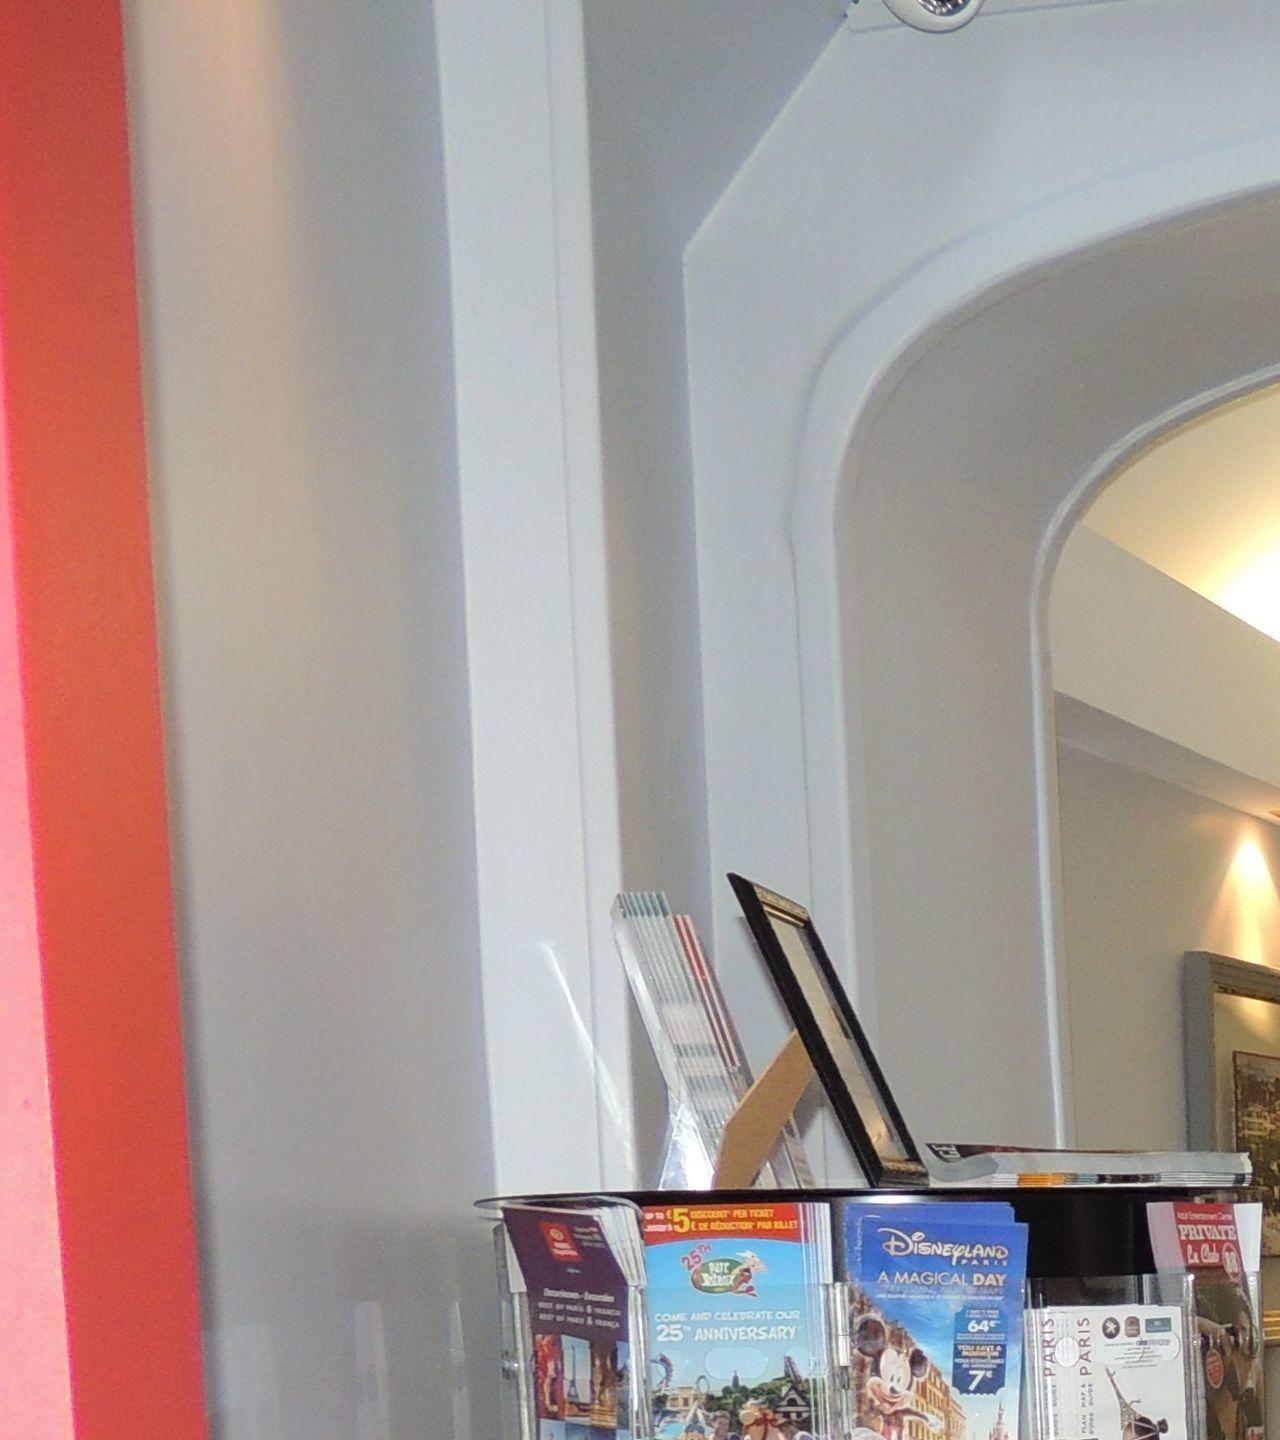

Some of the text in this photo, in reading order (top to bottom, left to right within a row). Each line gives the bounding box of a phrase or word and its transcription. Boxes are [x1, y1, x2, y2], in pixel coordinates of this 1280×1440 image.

[1178, 1224, 1236, 1240] PRIVATE
[877, 1271, 1007, 1286] A MAGICAL DAY
[655, 1310, 800, 1322] COME AND CELEBRATE OUR
[695, 1326, 796, 1341] ANNIVERSARY
[1077, 1316, 1092, 1376] PARIS
